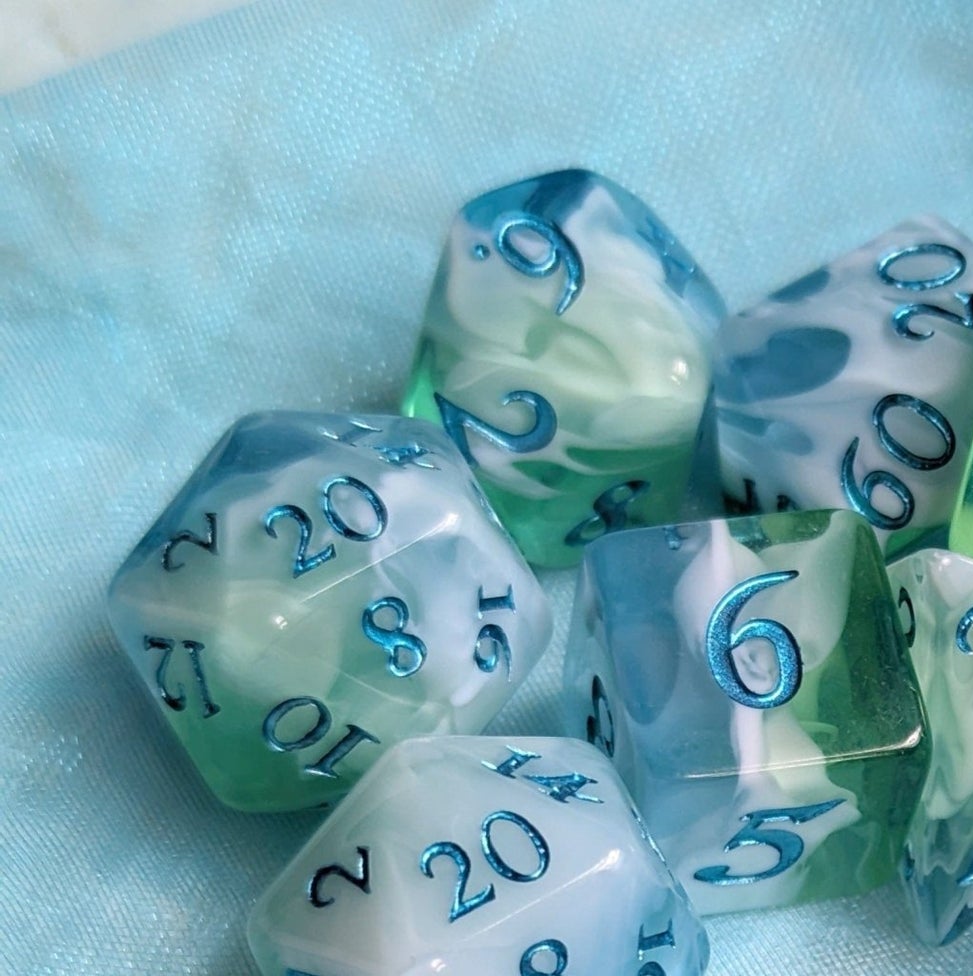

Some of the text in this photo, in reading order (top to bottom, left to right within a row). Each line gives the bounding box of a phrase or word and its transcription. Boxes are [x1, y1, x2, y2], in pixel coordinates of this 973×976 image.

[321, 417, 443, 471] 14
[434, 390, 558, 468] 2
[841, 393, 956, 531] 60
[161, 512, 219, 573] 2
[263, 475, 389, 578] 20
[362, 595, 428, 678] 8
[474, 583, 518, 682] 16
[706, 569, 804, 710] 6
[143, 634, 221, 719] 12
[262, 695, 382, 779] 10
[481, 745, 604, 804] 14
[309, 846, 372, 909] 2
[419, 810, 550, 923] 20
[693, 799, 848, 887] 5
